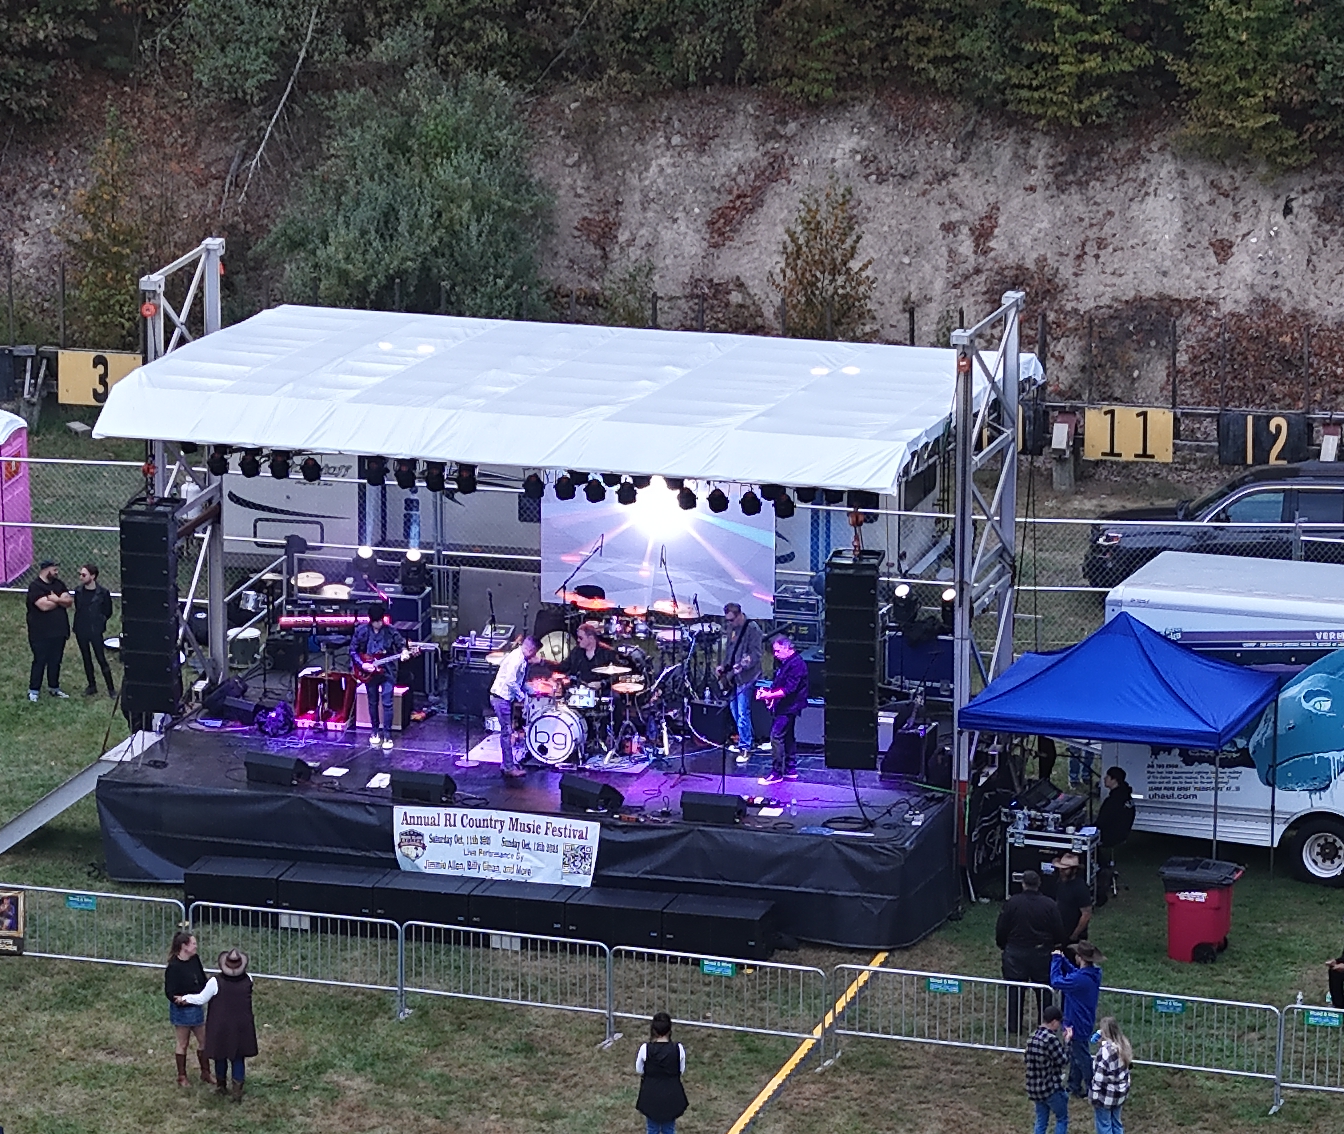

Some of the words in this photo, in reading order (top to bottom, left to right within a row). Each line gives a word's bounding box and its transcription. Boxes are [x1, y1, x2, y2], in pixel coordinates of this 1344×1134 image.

[92, 354, 109, 403] 3
[1100, 408, 1155, 459] 11
[1246, 415, 1288, 465] 12
[534, 725, 567, 750] bg
[401, 811, 440, 827] Annual
[444, 813, 457, 827] RI
[461, 814, 505, 834] Country
[508, 817, 541, 835] Music
[544, 821, 588, 840] Festival
